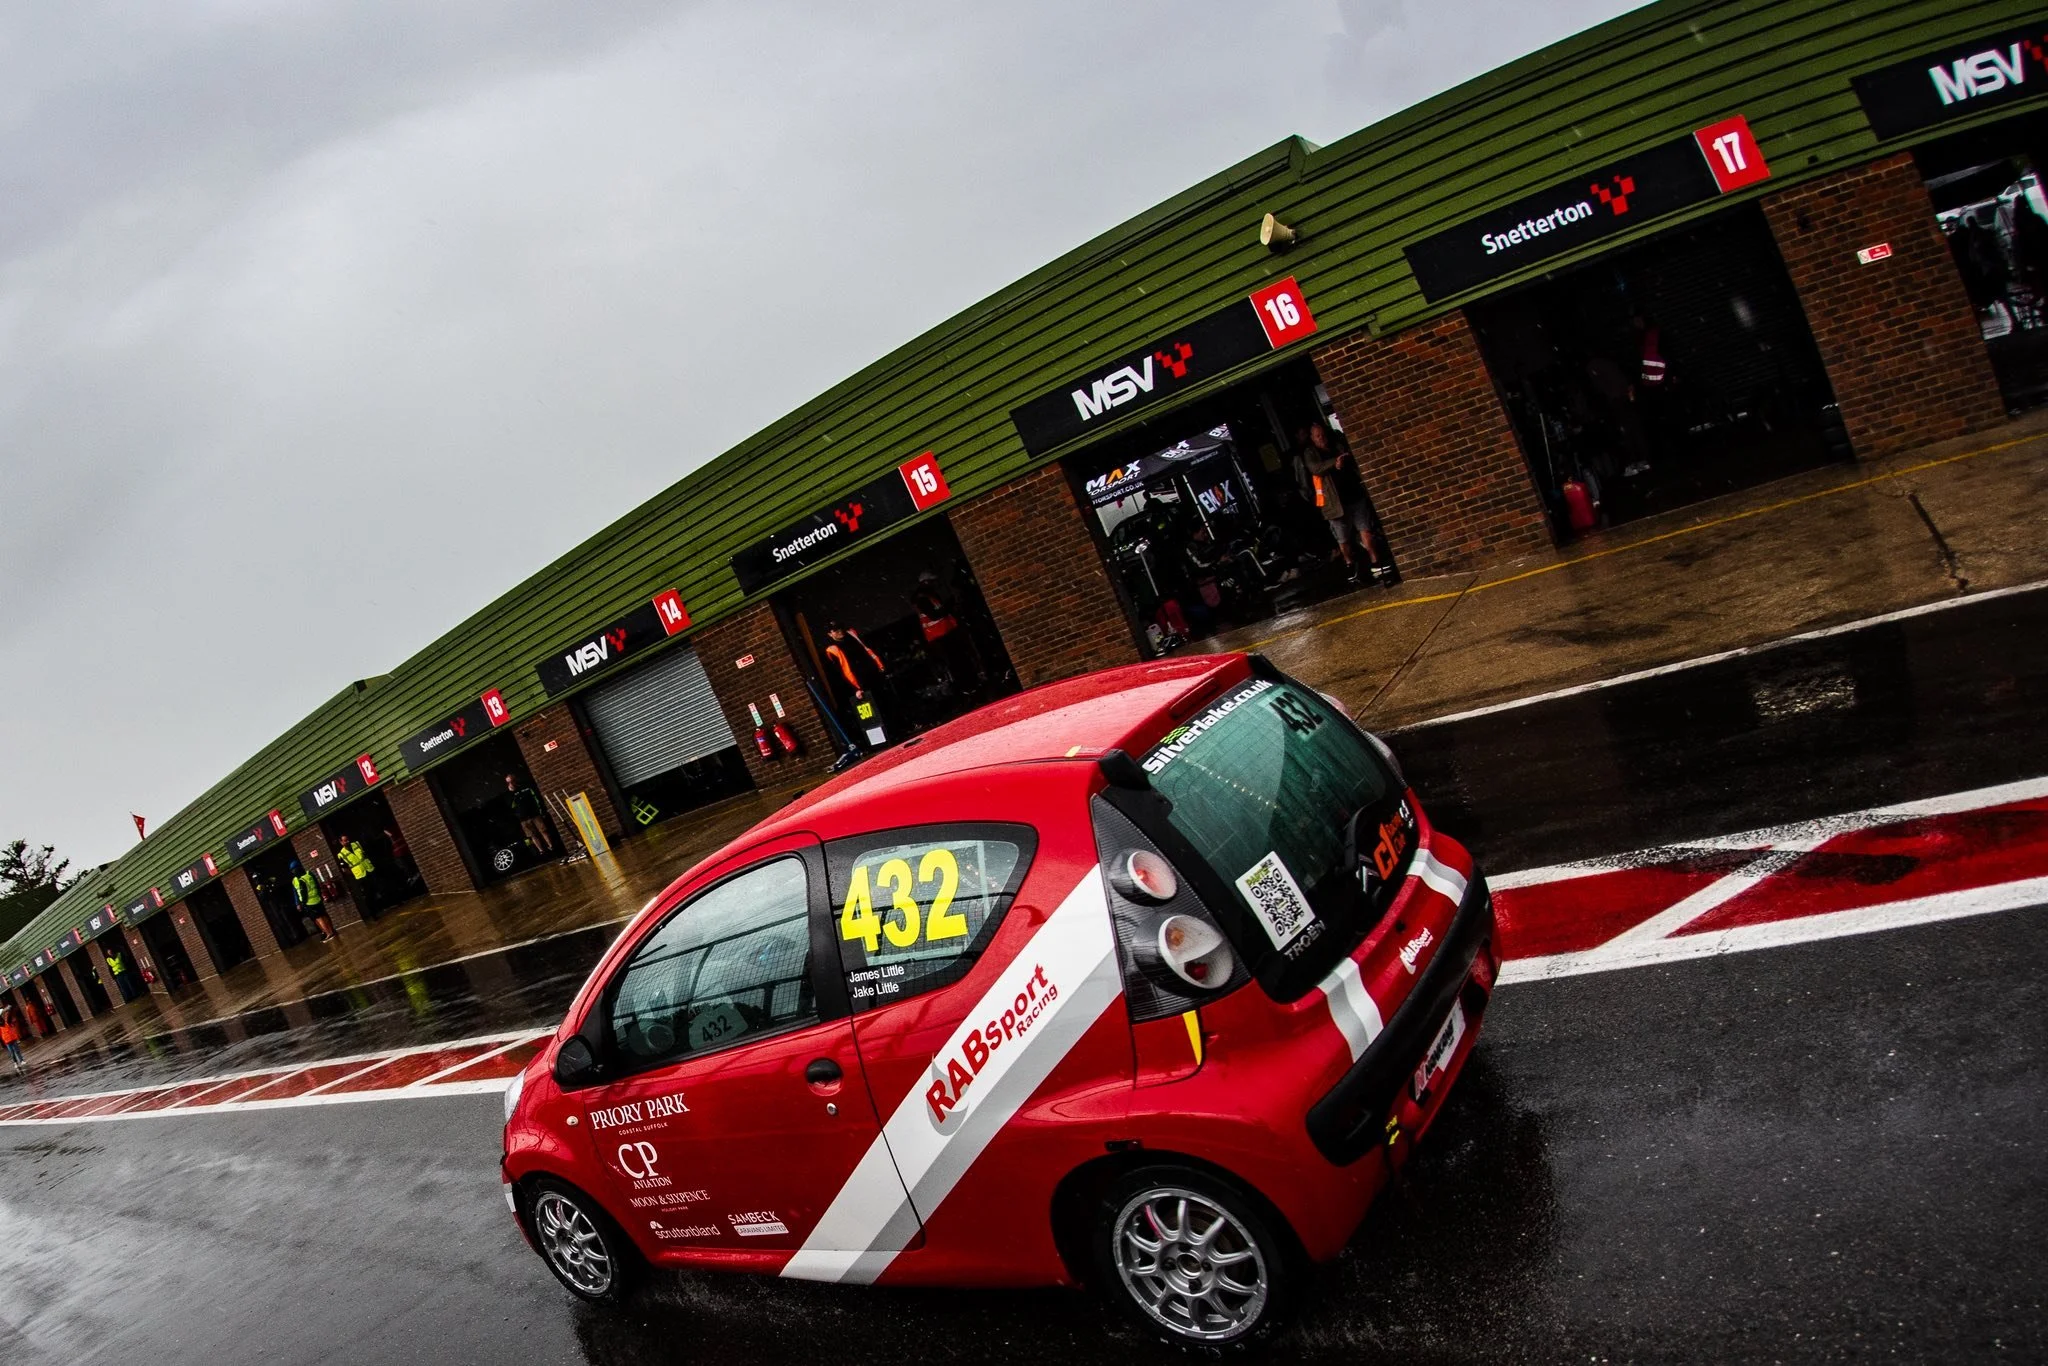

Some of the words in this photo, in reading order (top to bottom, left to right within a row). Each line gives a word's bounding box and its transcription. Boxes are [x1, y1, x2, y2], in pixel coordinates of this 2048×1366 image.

[1928, 42, 2025, 106] MSV
[1712, 131, 1747, 174] 17
[1481, 201, 1593, 255] Snetterton
[1264, 293, 1300, 331] 16
[1071, 355, 1154, 421] MSV
[910, 464, 939, 497] 15
[1086, 459, 1141, 492] MAX
[772, 522, 838, 563] Snetterton
[661, 597, 682, 625] 14
[565, 635, 609, 677] MSV
[487, 696, 504, 718] 13
[857, 702, 873, 720] 587
[1269, 691, 1324, 735] 432
[420, 729, 454, 753] Snetterton
[1142, 679, 1273, 775] Silverlake.co.uk
[361, 760, 375, 778] 12
[313, 780, 338, 807] MSV
[273, 815, 283, 830] 11
[841, 849, 969, 952] 432
[850, 969, 880, 983] James
[881, 964, 905, 979] Little
[853, 985, 875, 999] Jake
[875, 982, 900, 995] Little
[1016, 984, 1059, 1037] Racing
[701, 1014, 732, 1043] 432
[926, 963, 1049, 1124] RABsport
[590, 1102, 643, 1130] PRIORY
[645, 1092, 690, 1119] PARK
[618, 1127, 642, 1136] COASTAL
[643, 1122, 668, 1131] SUFFOLK
[618, 1141, 659, 1179] CP
[630, 1195, 659, 1208] MOON
[658, 1194, 668, 1205] &
[665, 1189, 711, 1204] SIXPENCE
[633, 1176, 673, 1190] AVIATION
[655, 1224, 721, 1240] scruttonbland
[727, 1210, 781, 1225] SAMBECK
[736, 1226, 764, 1234] CARAVANS
[763, 1224, 787, 1233] LIMITED
